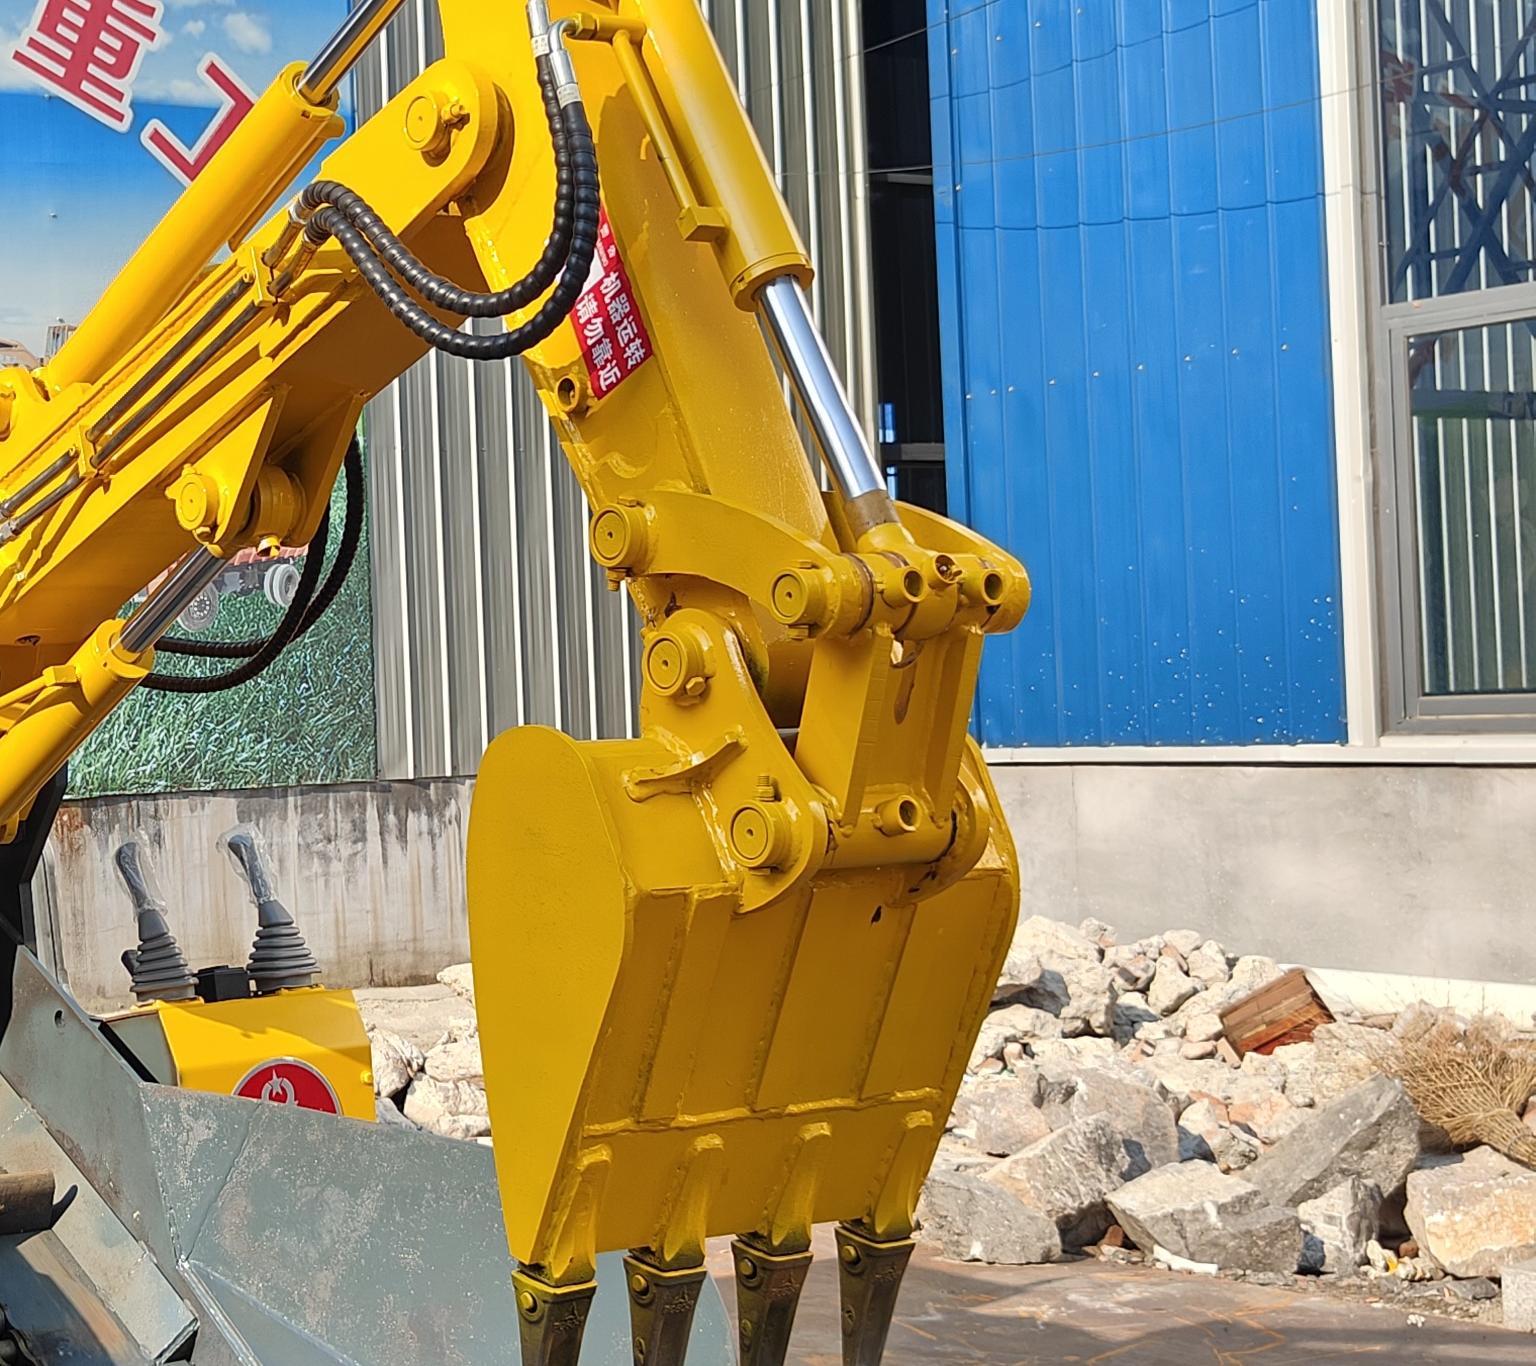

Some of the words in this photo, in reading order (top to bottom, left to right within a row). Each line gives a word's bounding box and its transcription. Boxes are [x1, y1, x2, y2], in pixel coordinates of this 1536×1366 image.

[576, 293, 621, 391] 请勿靠近
[600, 272, 646, 369] 机器运转
